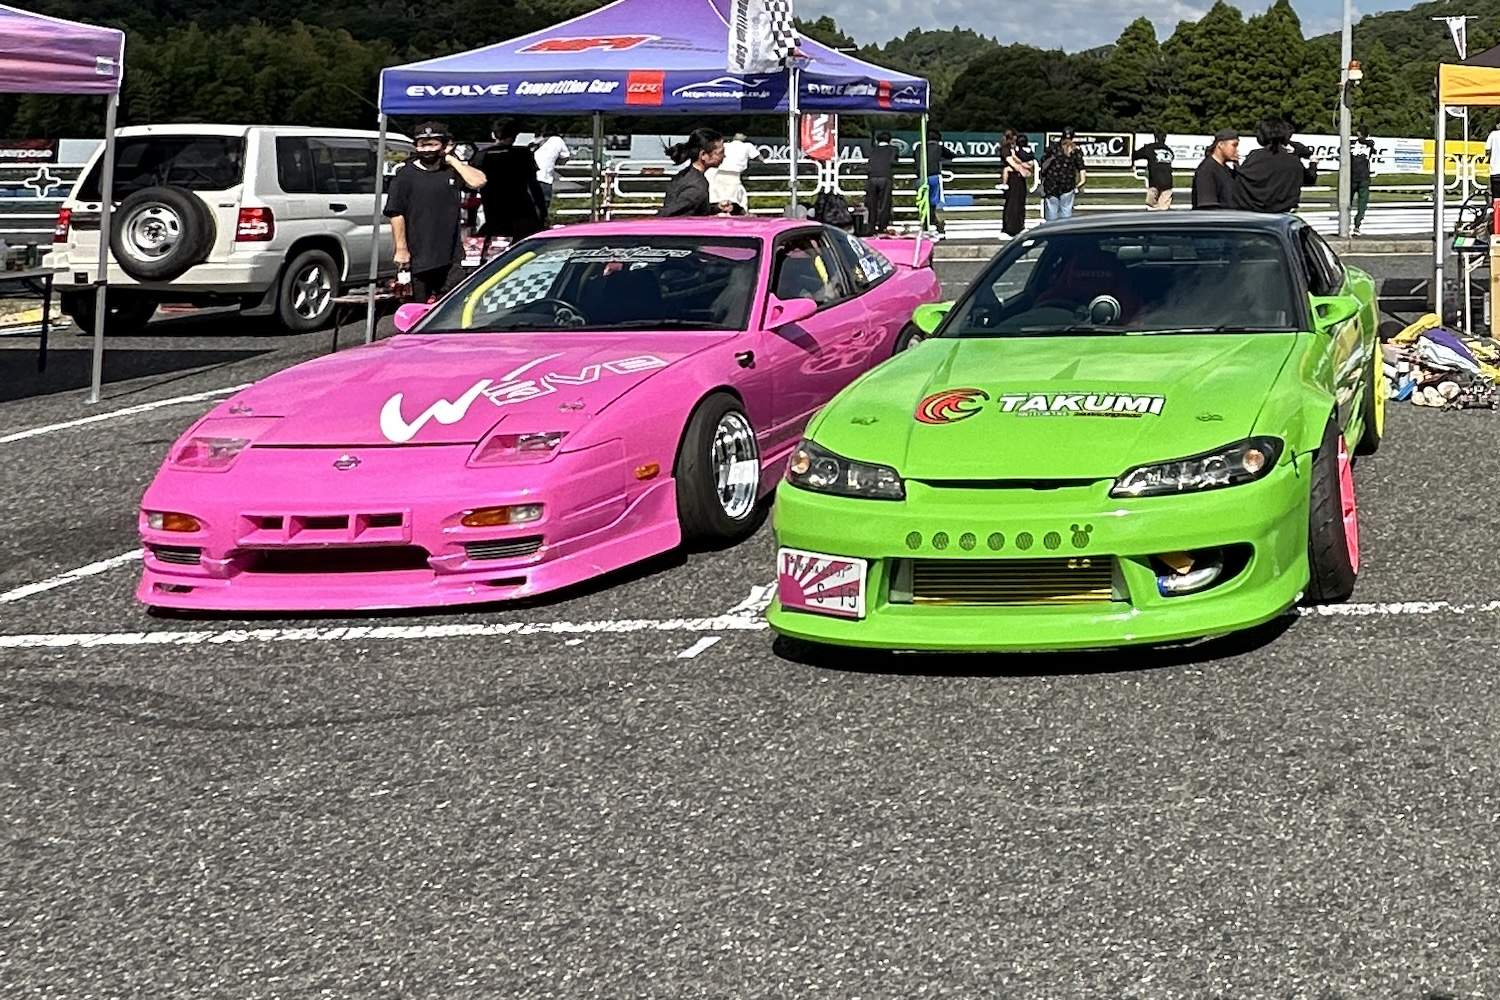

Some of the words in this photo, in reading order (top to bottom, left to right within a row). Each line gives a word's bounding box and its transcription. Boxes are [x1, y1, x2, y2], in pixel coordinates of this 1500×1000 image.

[405, 83, 510, 97] EVOLVE
[515, 79, 586, 97] Competition
[587, 79, 619, 94] Gear
[1000, 395, 1166, 416] TAKUMI
